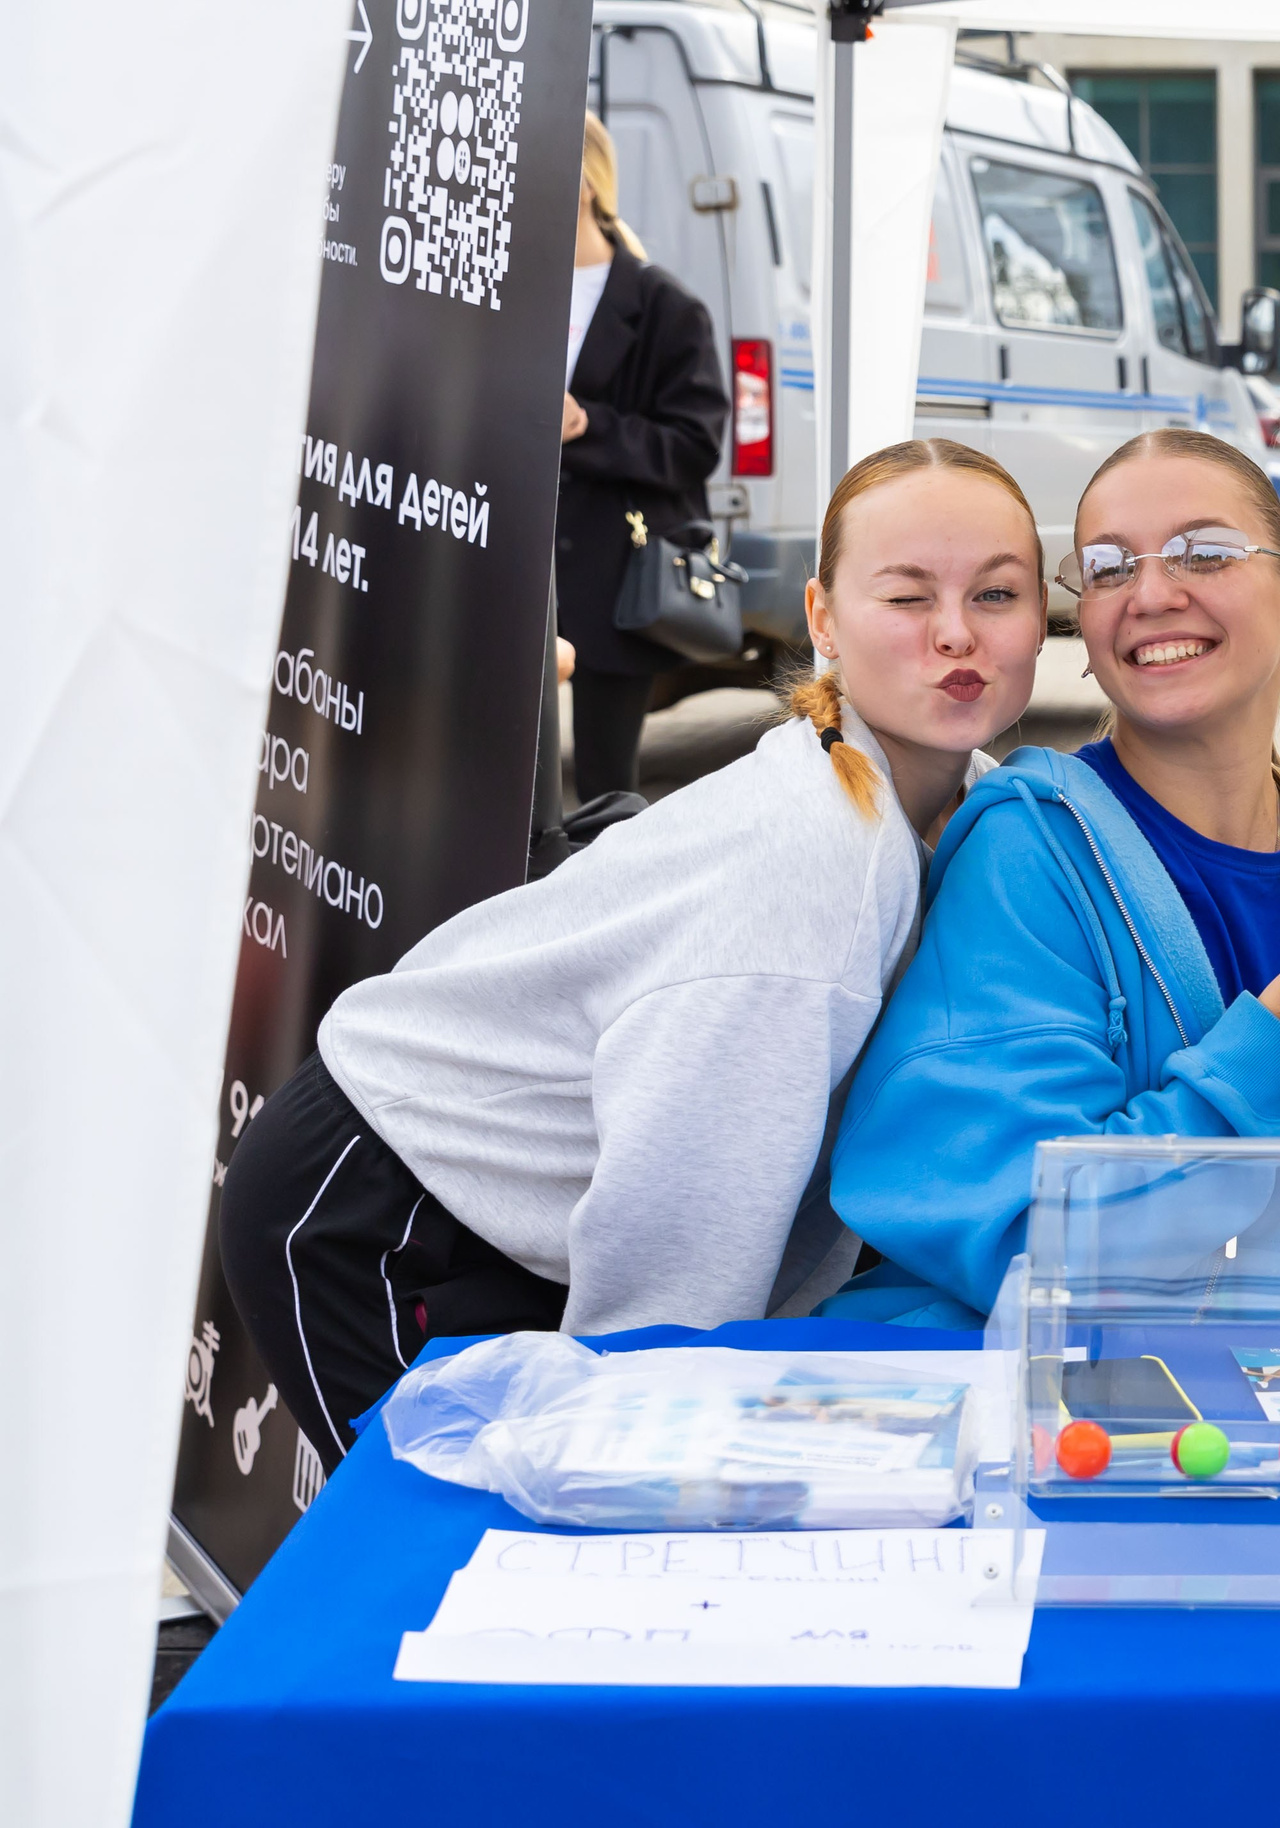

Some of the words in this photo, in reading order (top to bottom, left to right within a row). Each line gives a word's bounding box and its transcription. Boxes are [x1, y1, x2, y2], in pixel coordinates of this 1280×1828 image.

[338, 450, 394, 510] для
[398, 472, 490, 549] детей
[321, 532, 369, 593] лет.
[497, 1535, 1001, 1572] СТРЕТЧИНГ
